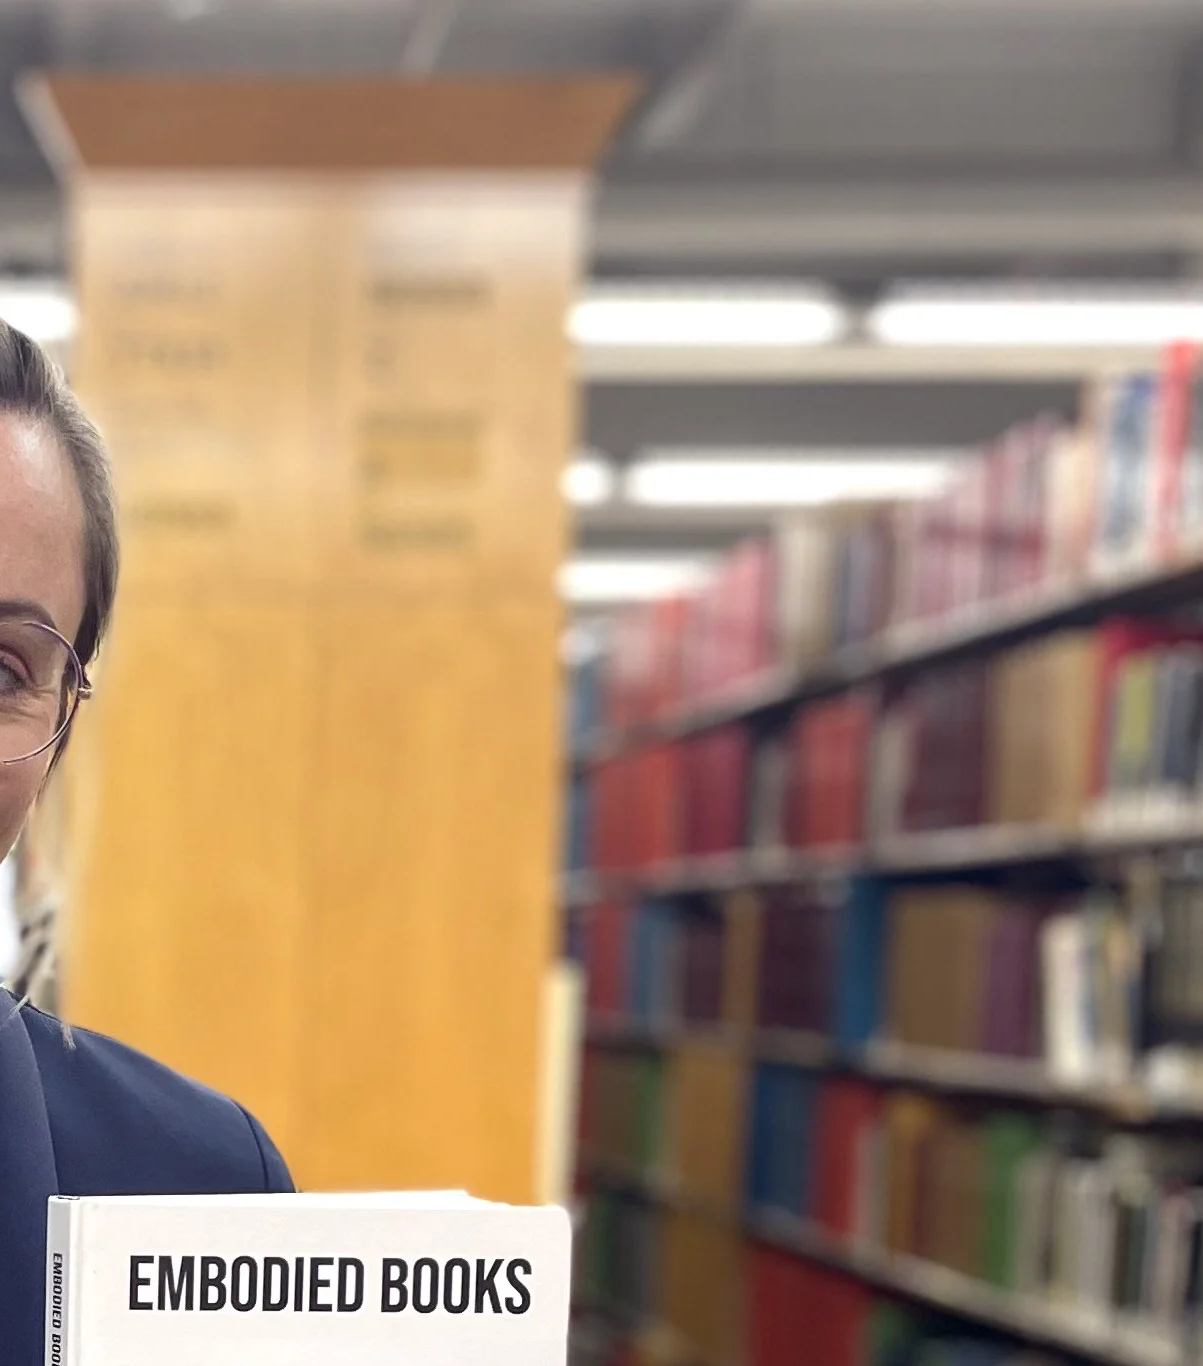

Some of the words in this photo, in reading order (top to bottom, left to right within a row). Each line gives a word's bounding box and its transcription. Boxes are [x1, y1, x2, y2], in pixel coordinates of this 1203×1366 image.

[52, 1252, 63, 1329] EMBODIED
[129, 1255, 364, 1312] EMBODIED
[381, 1257, 532, 1314] BOOKS
